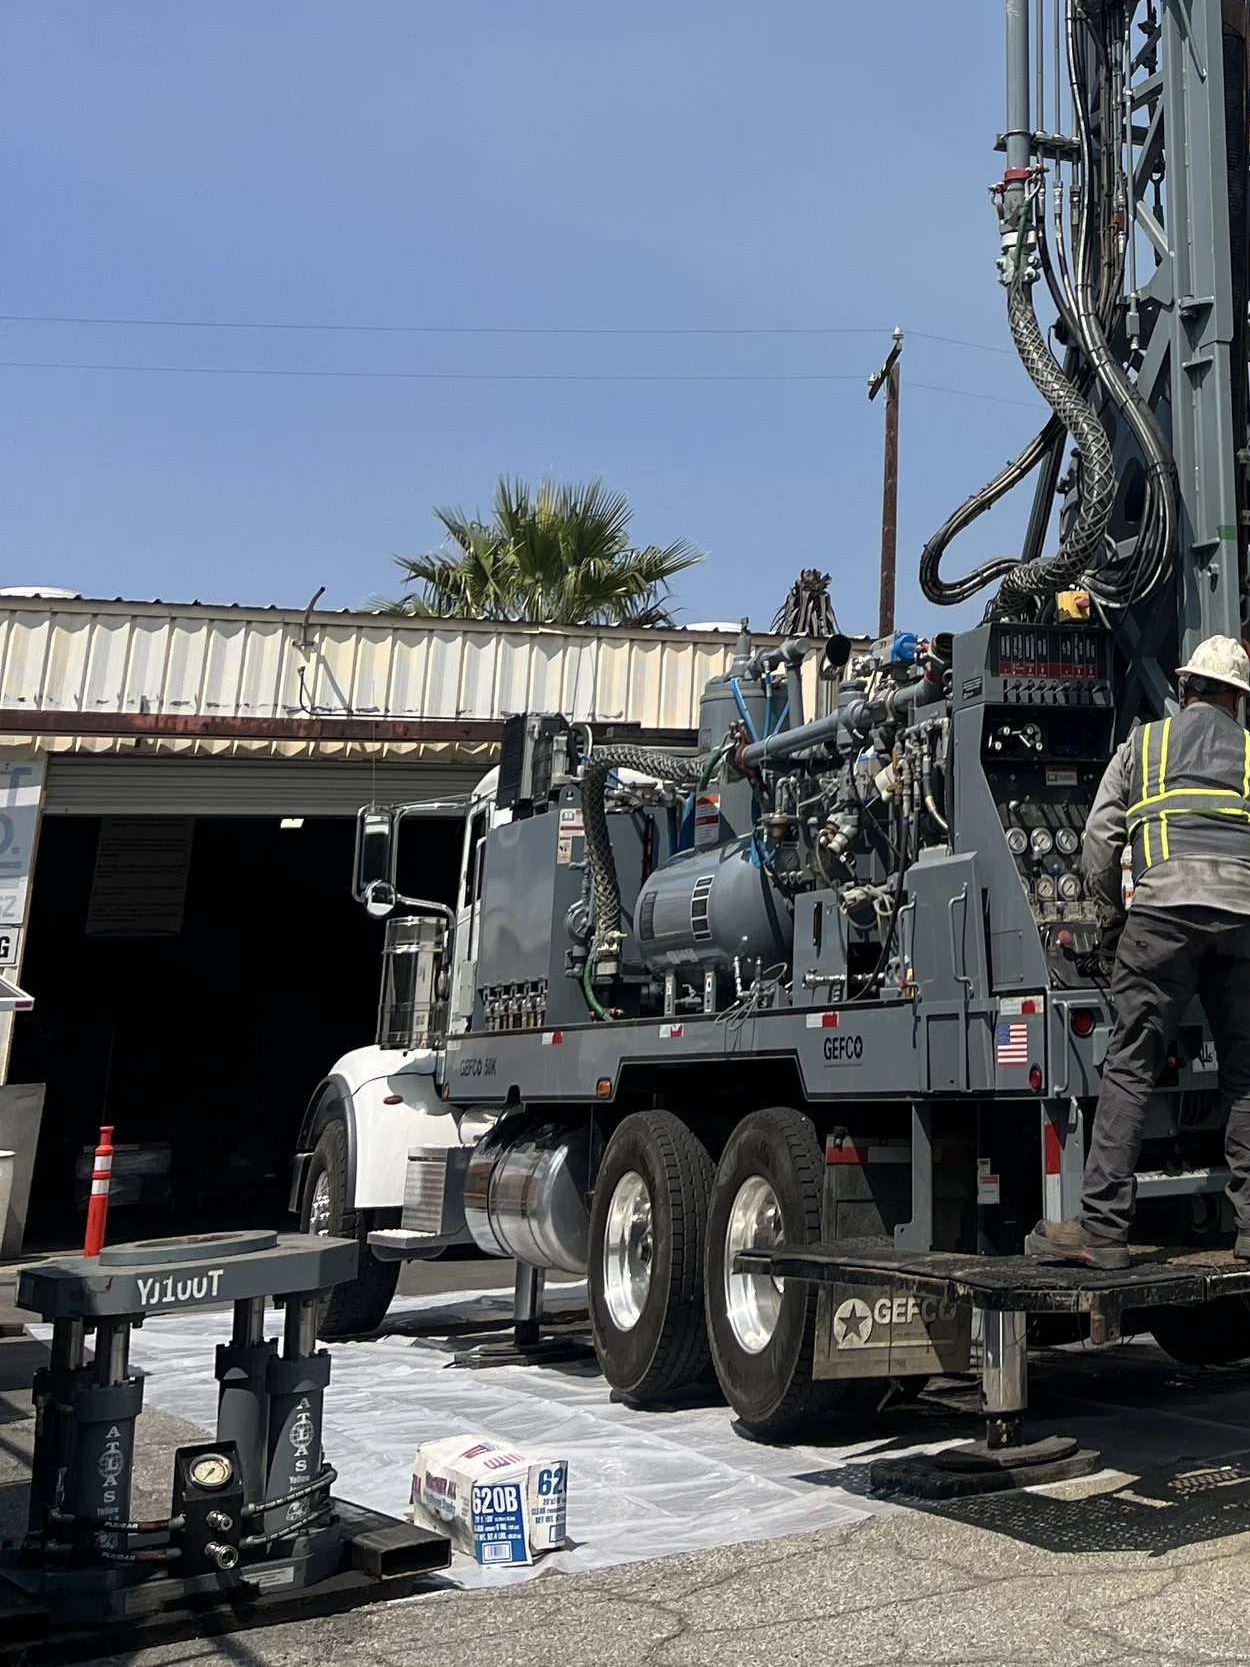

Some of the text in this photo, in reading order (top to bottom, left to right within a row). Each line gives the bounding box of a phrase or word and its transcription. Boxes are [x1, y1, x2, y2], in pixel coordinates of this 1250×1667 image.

[824, 1035, 864, 1060] GEFCO
[460, 1058, 482, 1077] GEFCO
[874, 1297, 957, 1325] GEFCO
[292, 1397, 312, 1473] ATLAS
[102, 1425, 122, 1504] ATLAS
[537, 1466, 568, 1496] 62
[472, 1486, 519, 1514] 620B
